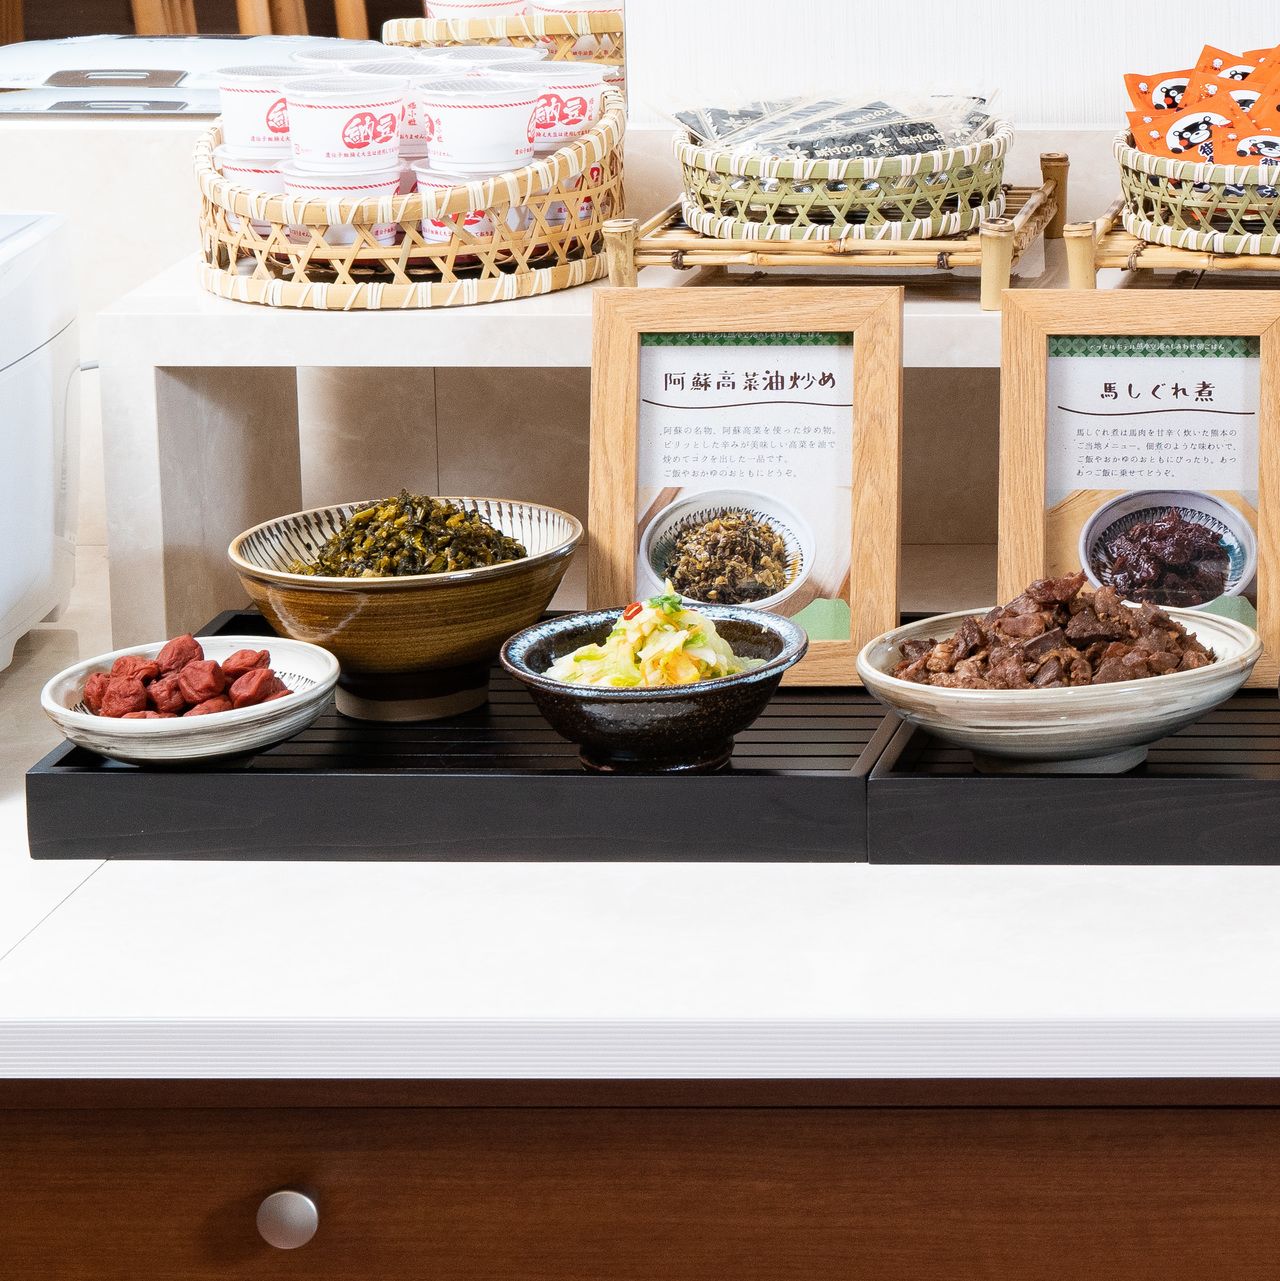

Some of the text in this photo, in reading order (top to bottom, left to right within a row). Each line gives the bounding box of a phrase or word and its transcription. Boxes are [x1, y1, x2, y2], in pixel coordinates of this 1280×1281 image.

[897, 131, 945, 146] 味付のり
[814, 144, 864, 158] 味付のり
[664, 370, 836, 391] 阿蘇高菜油炒め
[1101, 381, 1215, 402] 馬しぐれ煮
[1077, 428, 1237, 438] 馬しぐれ煮は馬肉を甘辛く炊いた熊本の
[1077, 468, 1176, 478] あつご飯に乗せてどうぞ。
